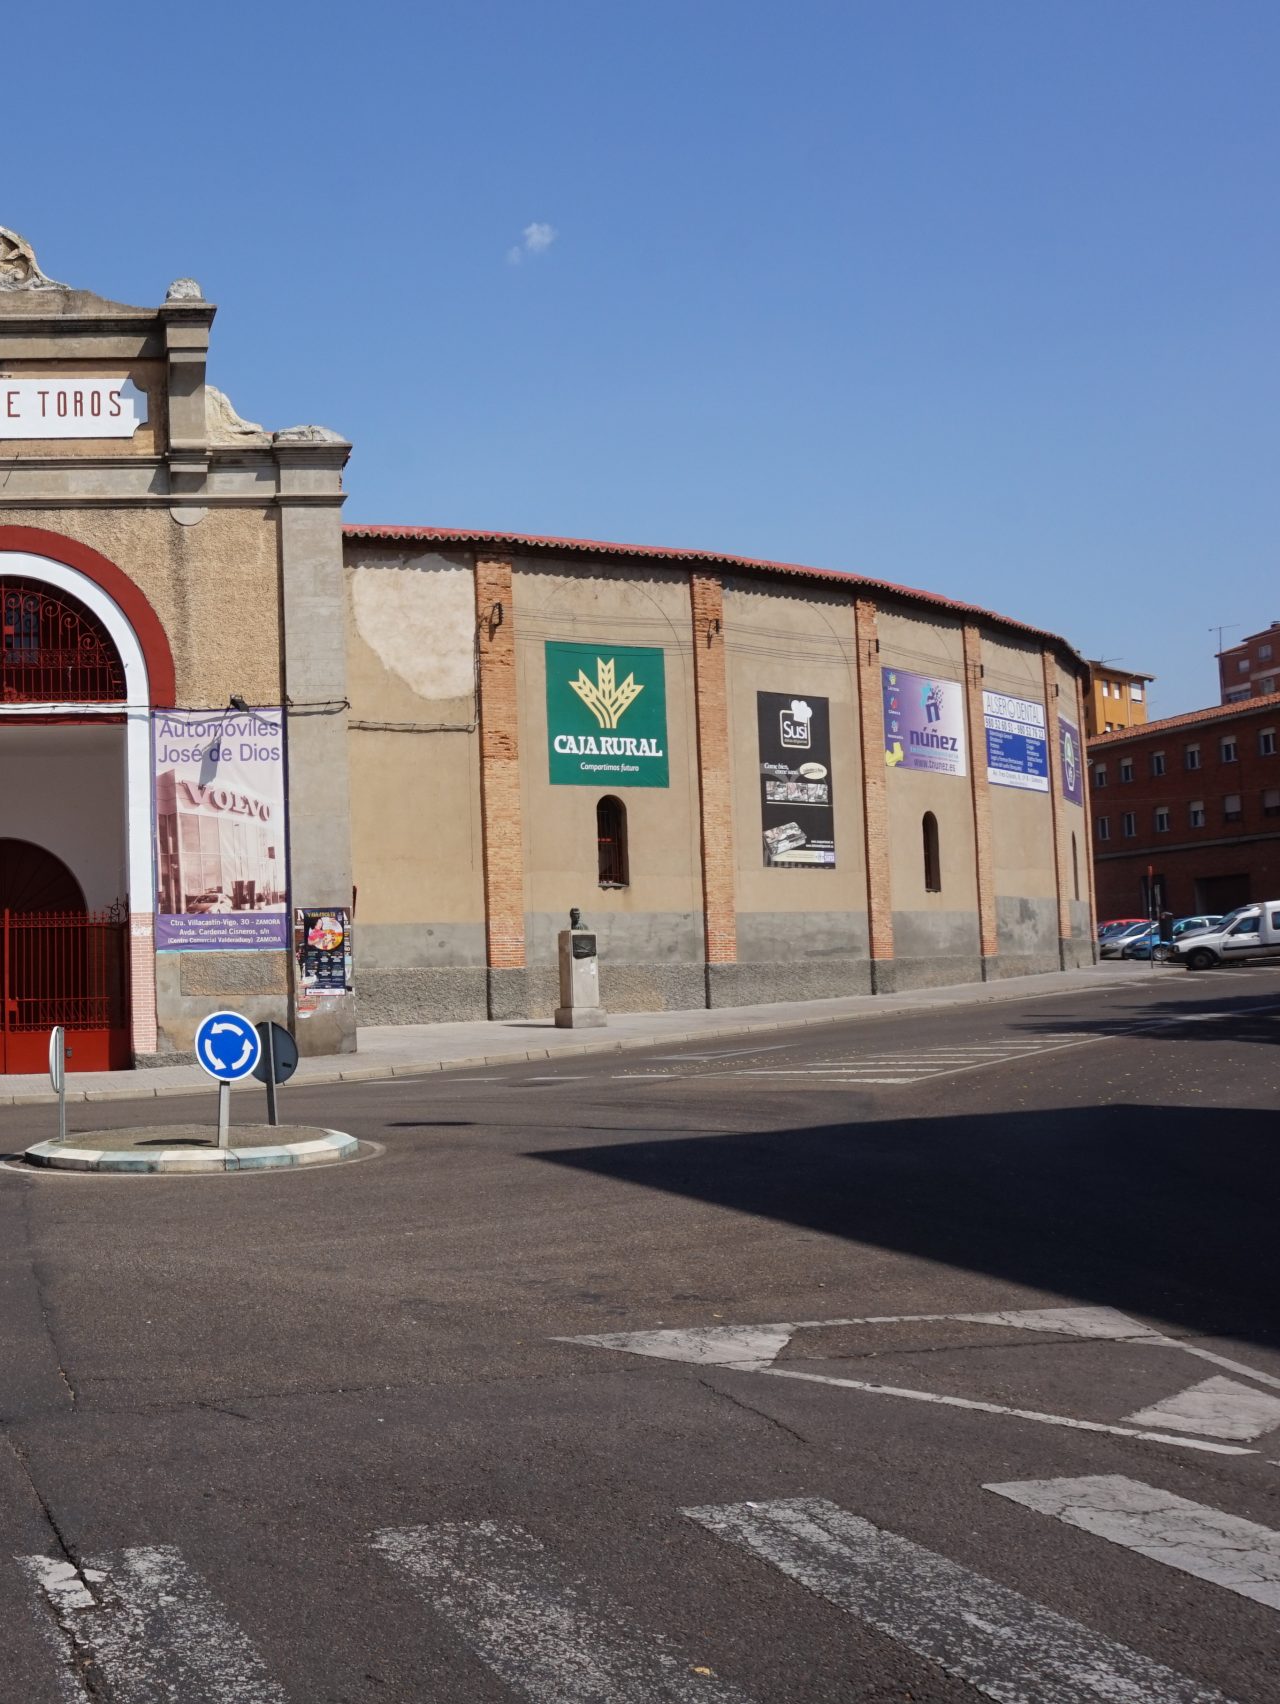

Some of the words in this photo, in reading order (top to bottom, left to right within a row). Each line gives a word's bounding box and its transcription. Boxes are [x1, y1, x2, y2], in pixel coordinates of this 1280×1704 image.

[37, 390, 122, 417] TOROS
[160, 718, 279, 738] Automóviles
[783, 720, 808, 740] Susi
[553, 735, 600, 755] CAJA
[599, 737, 663, 757] RURAL
[909, 726, 959, 752] núñez
[158, 743, 202, 763] José
[209, 742, 233, 762] de
[239, 743, 280, 762] Dios
[580, 762, 620, 772] Compartimos
[620, 764, 640, 773] futuro
[181, 780, 270, 822] VOLVO
